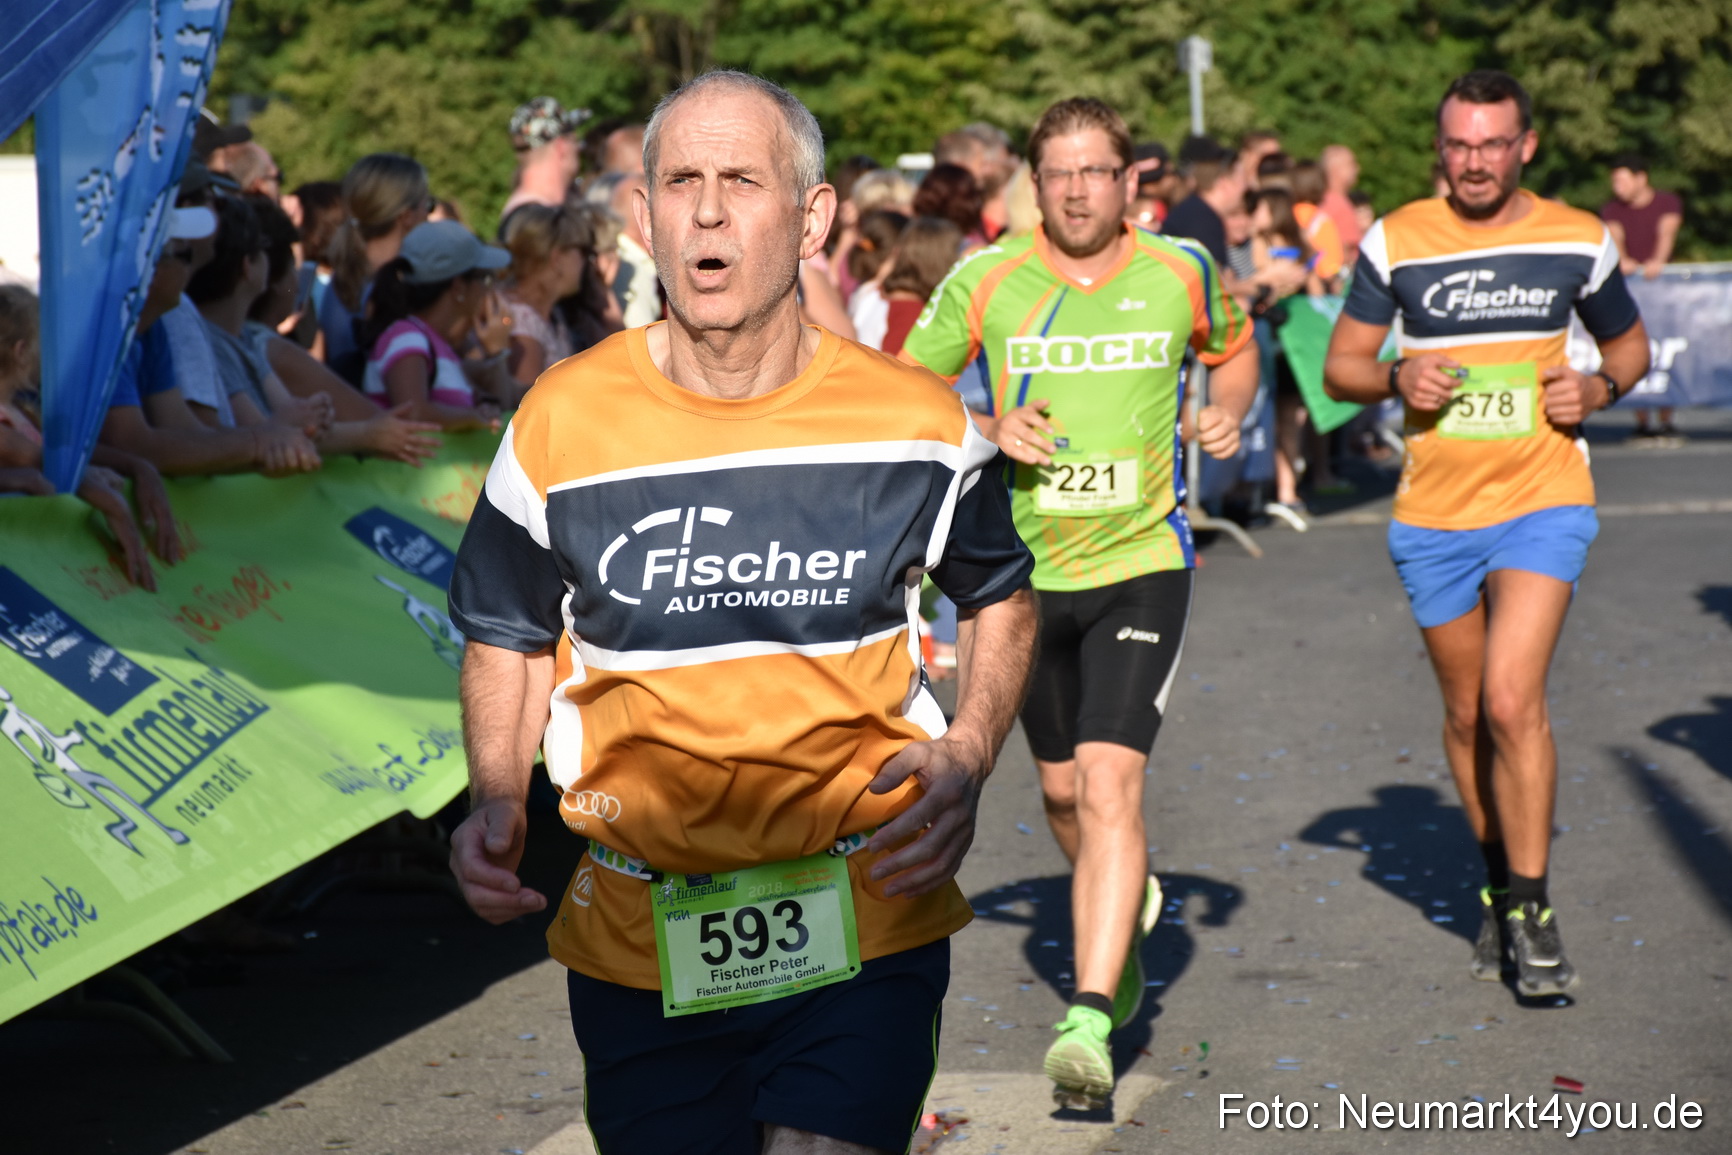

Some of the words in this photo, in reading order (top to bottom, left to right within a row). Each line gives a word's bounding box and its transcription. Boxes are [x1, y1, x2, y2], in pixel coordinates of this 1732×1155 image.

[1447, 284, 1558, 311] Fischer
[1456, 305, 1550, 321] AUTOMOBILE
[1006, 331, 1173, 374] BOCK
[1459, 392, 1515, 418] 578
[1057, 463, 1115, 492] 221
[642, 541, 867, 591] Fischer
[664, 588, 850, 615] AUTOMOBILE
[8, 610, 67, 650] Fischer
[73, 646, 269, 804] firmenlauf
[175, 752, 253, 827] neumarkt
[675, 876, 738, 899] firmenlauf
[748, 881, 784, 898] 2018
[700, 899, 810, 966] 593
[696, 984, 734, 998] Fischer
[734, 973, 793, 992] Automobile
[794, 963, 826, 980] GmbH
[710, 962, 766, 983] Fischer
[769, 954, 809, 973] Peter
